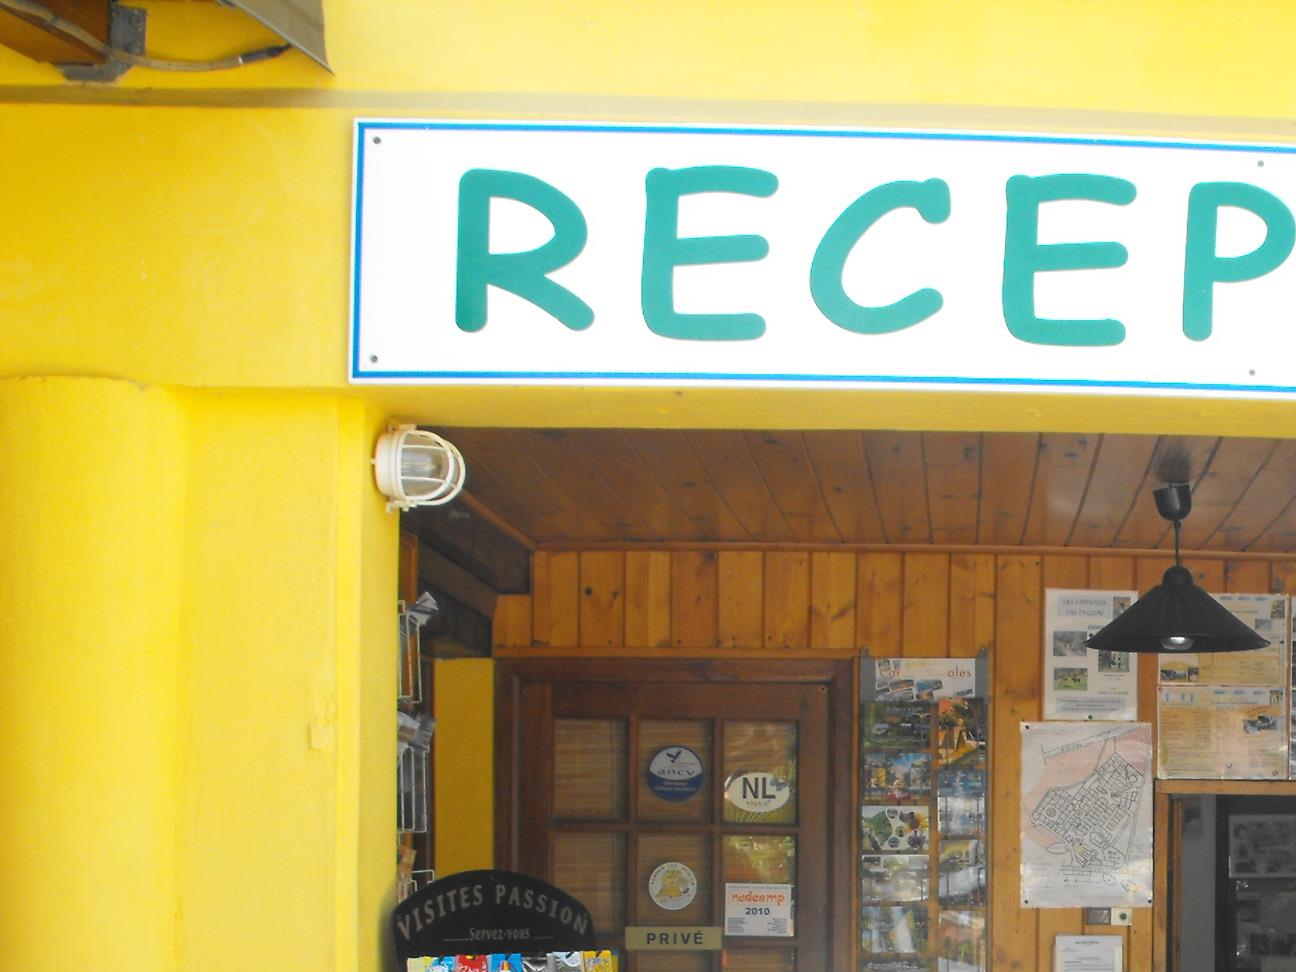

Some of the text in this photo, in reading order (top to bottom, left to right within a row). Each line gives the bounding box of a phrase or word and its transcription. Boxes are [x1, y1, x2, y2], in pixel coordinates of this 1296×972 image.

[742, 777, 776, 799] NL
[397, 885, 589, 940] VISITES PASSION
[745, 907, 771, 916] 2010
[646, 929, 704, 945] PRIVÉ
